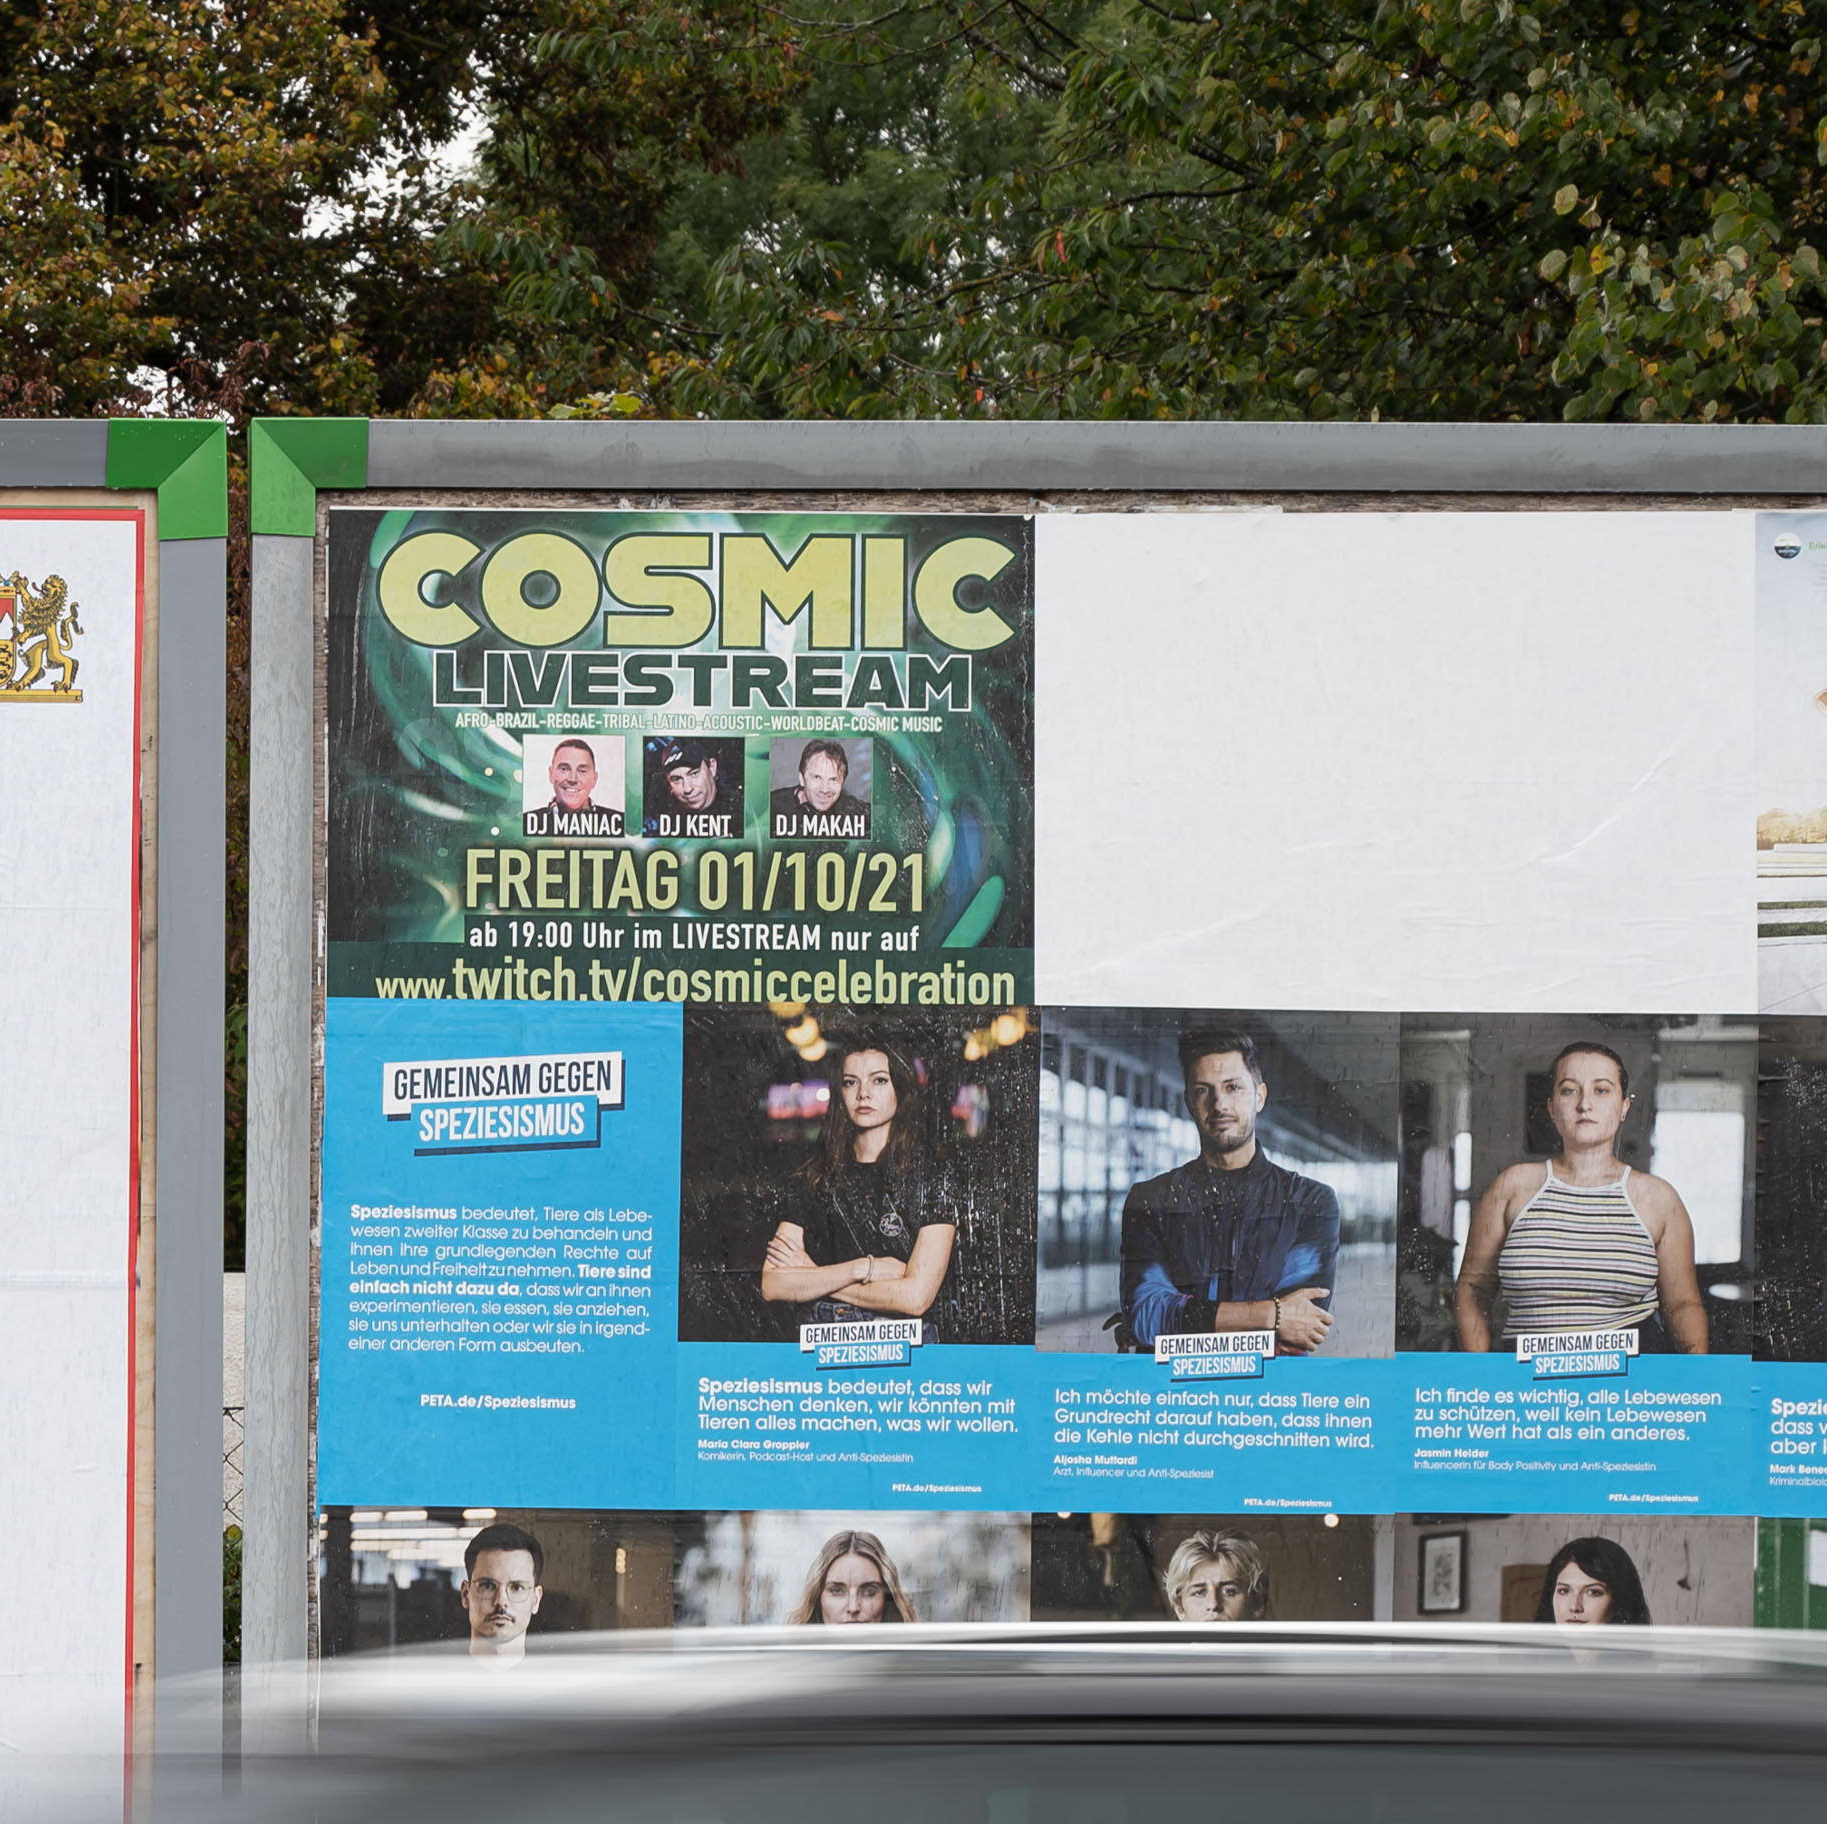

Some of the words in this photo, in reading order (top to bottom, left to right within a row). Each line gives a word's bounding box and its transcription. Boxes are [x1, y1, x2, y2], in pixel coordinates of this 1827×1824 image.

[377, 530, 1019, 651] COSMIC
[433, 650, 973, 711] LIVESTREAM
[902, 715, 943, 734] MUSIC
[526, 813, 548, 835] DJ
[553, 813, 622, 836] MANIAC
[659, 814, 681, 836] DJ
[686, 814, 732, 837] KENT
[776, 814, 797, 836] DJ
[803, 814, 865, 837] MAKAH
[466, 849, 679, 911] FREITAG
[698, 850, 924, 913] 01/10/21
[469, 921, 497, 947] ab
[508, 921, 572, 948] 19:00
[583, 922, 625, 949] Uhr
[634, 922, 662, 949] im
[672, 922, 821, 951] LIVESTREAM
[831, 931, 872, 951] nur
[880, 925, 920, 951] auf
[376, 957, 1016, 1005] www.twitch.tv/cosmiccelebration
[393, 1063, 532, 1100] GEMEINSAM
[538, 1060, 612, 1094] GEGEN
[418, 1102, 585, 1142] SPEZIESISMUS
[350, 1203, 458, 1222] Speziesismus
[461, 1206, 539, 1221] bedeutet,
[543, 1206, 580, 1222] Tiere
[583, 1208, 605, 1222] als
[608, 1207, 653, 1223] Lebe-
[350, 1225, 401, 1238] wesen
[403, 1223, 459, 1239] zweiter
[462, 1223, 509, 1240] Klasse
[511, 1227, 529, 1240] zu
[532, 1225, 619, 1241] behandeln
[621, 1227, 653, 1242] und
[350, 1241, 394, 1257] ihnen
[400, 1242, 429, 1257] ihre
[434, 1243, 557, 1261] grundlegenden
[563, 1244, 620, 1260] Rechte
[626, 1245, 653, 1261] auf
[350, 1260, 399, 1276] Leben
[400, 1261, 431, 1276] und
[432, 1261, 488, 1277] Freiheit
[487, 1264, 506, 1277] zu
[506, 1263, 577, 1279] nehmen.
[576, 1263, 617, 1279] Tiere
[617, 1264, 653, 1280] sind
[805, 1325, 876, 1344] GEMEINSAM
[879, 1323, 917, 1341] GEGEN
[1522, 1335, 1593, 1354] GEMEINSAM
[1595, 1332, 1634, 1350] GEGEN
[818, 1344, 903, 1364] SPEZIESISMUS
[1160, 1337, 1229, 1355] GEMEINSAM
[1231, 1334, 1271, 1353] GEGEN
[1173, 1356, 1256, 1376] SPEZIESISMUS
[1535, 1355, 1620, 1374] SPEZIESISMUS
[699, 1378, 823, 1397] Speziesismus
[827, 1378, 915, 1397] bedeutet,
[919, 1379, 962, 1396] dass
[966, 1380, 993, 1396] wir
[1415, 1387, 1442, 1404] Ich
[1445, 1387, 1491, 1405] finde
[1494, 1390, 1515, 1404] es
[1519, 1389, 1583, 1408] wichtig,
[1586, 1388, 1620, 1405] alle
[1624, 1389, 1722, 1406] Lebewesen
[419, 1392, 578, 1411] PETA.de/Speziesismus
[698, 1396, 794, 1412] Menschen
[799, 1396, 873, 1415] denken,
[877, 1397, 904, 1413] wir
[908, 1397, 982, 1414] könnten
[987, 1398, 1016, 1414] mit
[1055, 1388, 1081, 1404] Ich
[1085, 1388, 1152, 1406] möchte
[1155, 1390, 1220, 1407] einfach
[1224, 1394, 1254, 1409] nur,
[1257, 1391, 1298, 1408] dass
[1300, 1392, 1340, 1409] Tiere
[1344, 1393, 1370, 1409] ein
[697, 1414, 751, 1430] Tieren
[754, 1414, 797, 1431] alles
[801, 1415, 882, 1433] machen,
[886, 1418, 922, 1432] was
[925, 1415, 952, 1432] wir
[955, 1416, 1019, 1433] wollen.
[1054, 1407, 1152, 1425] Grundrecht
[1154, 1409, 1213, 1426] darauf
[1216, 1410, 1278, 1429] haben,
[1281, 1412, 1321, 1428] dass
[1324, 1412, 1373, 1429] ihnen
[1414, 1408, 1434, 1421] zu
[1439, 1407, 1520, 1425] schützen,
[1524, 1407, 1560, 1422] weil
[1564, 1407, 1601, 1423] kein
[1606, 1407, 1707, 1423] Lebewesen
[1053, 1427, 1082, 1444] die
[1086, 1428, 1134, 1445] Kehle
[1137, 1429, 1180, 1445] nicht
[1184, 1430, 1330, 1449] durchgeschnitten
[1334, 1432, 1375, 1449] wird.
[1414, 1423, 1463, 1439] mehr
[1466, 1423, 1507, 1439] Wert
[1512, 1424, 1543, 1440] hat
[1546, 1424, 1573, 1440] als
[1577, 1424, 1606, 1441] ein
[1610, 1425, 1690, 1441] anderes.
